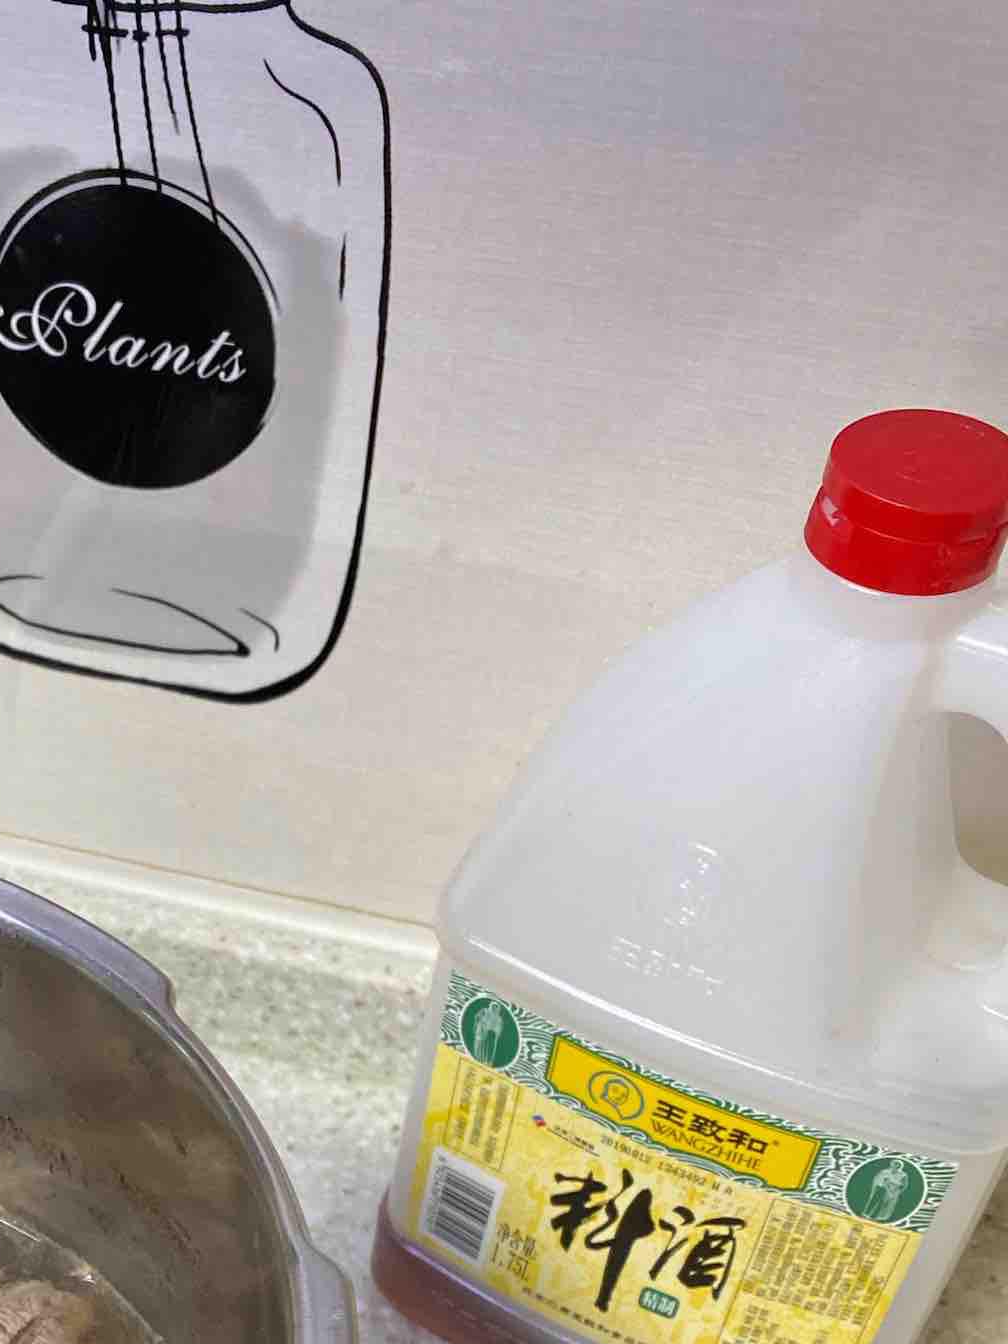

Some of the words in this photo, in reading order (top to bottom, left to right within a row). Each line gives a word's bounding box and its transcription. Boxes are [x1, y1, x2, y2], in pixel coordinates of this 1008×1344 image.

[651, 1117, 760, 1171] WANGZHIHE
[652, 1100, 768, 1155] 王致和
[550, 1168, 746, 1313] 料酒
